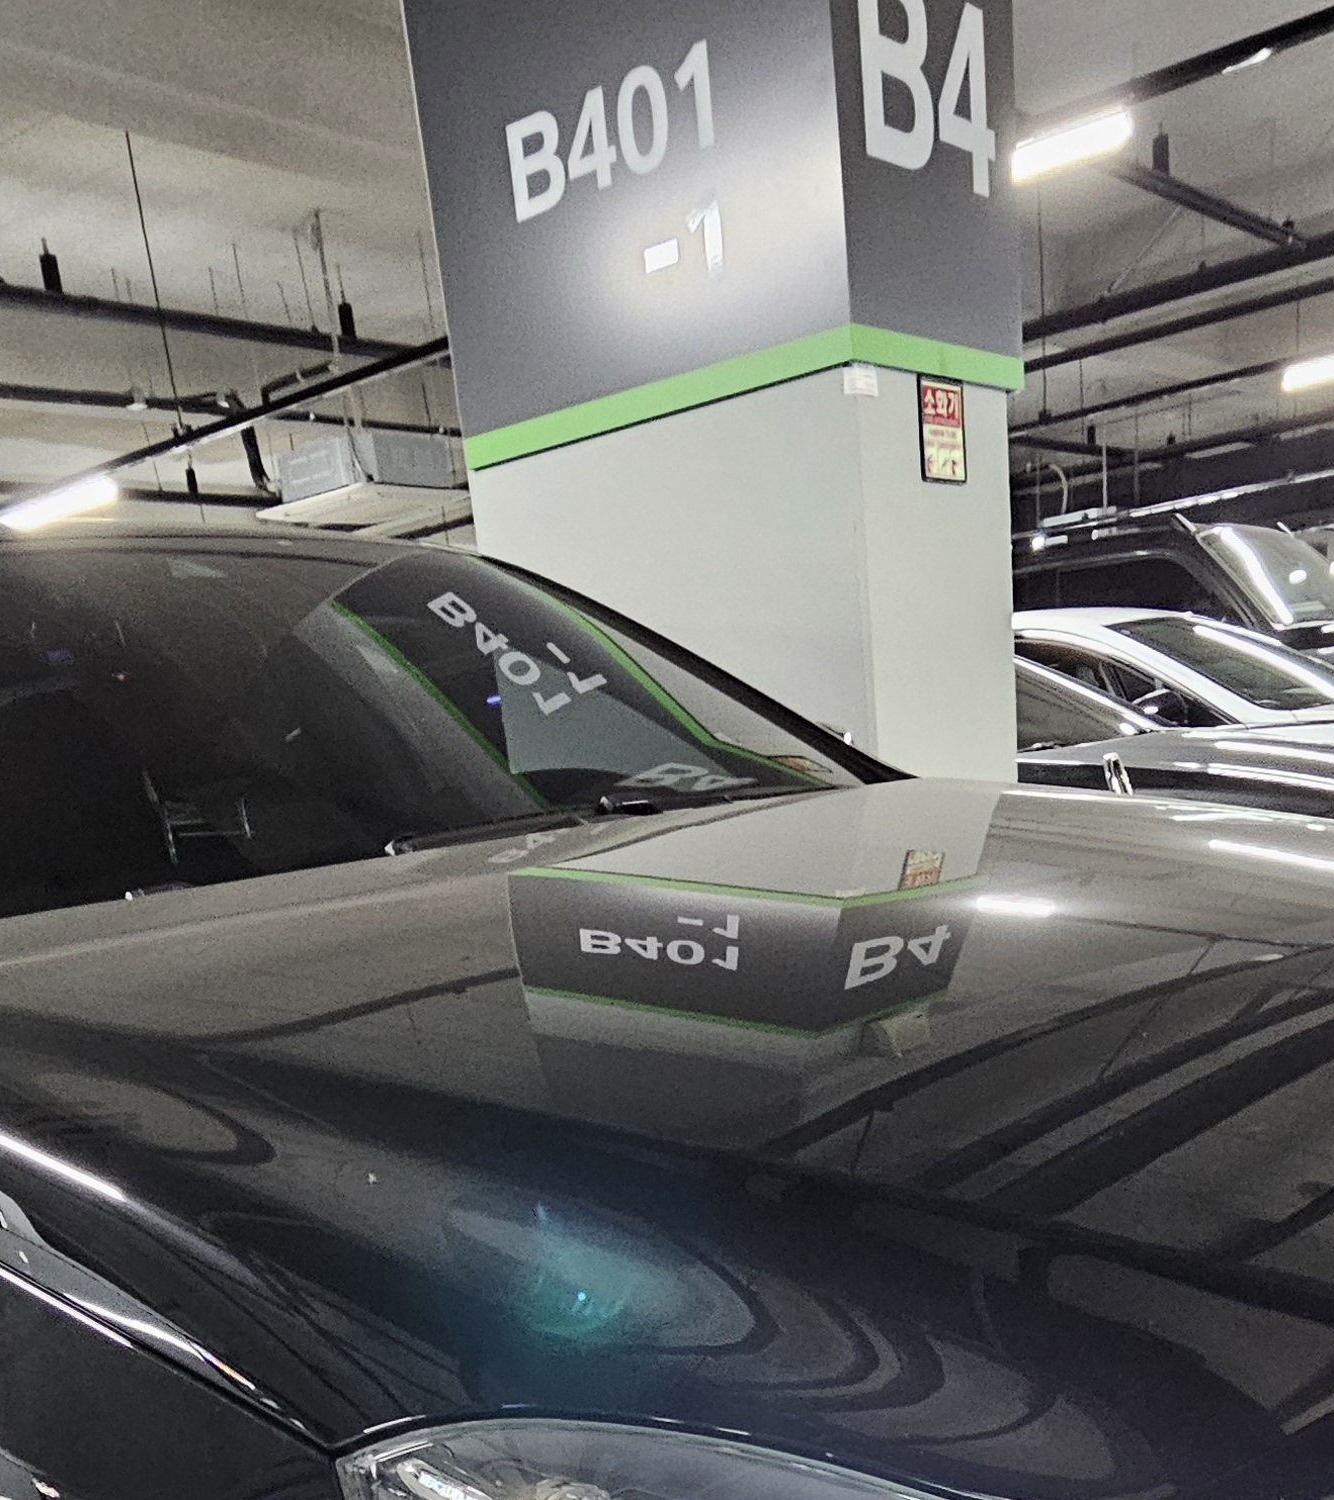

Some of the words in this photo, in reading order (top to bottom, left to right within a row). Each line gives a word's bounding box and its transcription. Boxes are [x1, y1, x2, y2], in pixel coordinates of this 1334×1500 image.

[506, 39, 715, 224] B401
[860, 0, 996, 198] B4
[644, 200, 724, 277] -1
